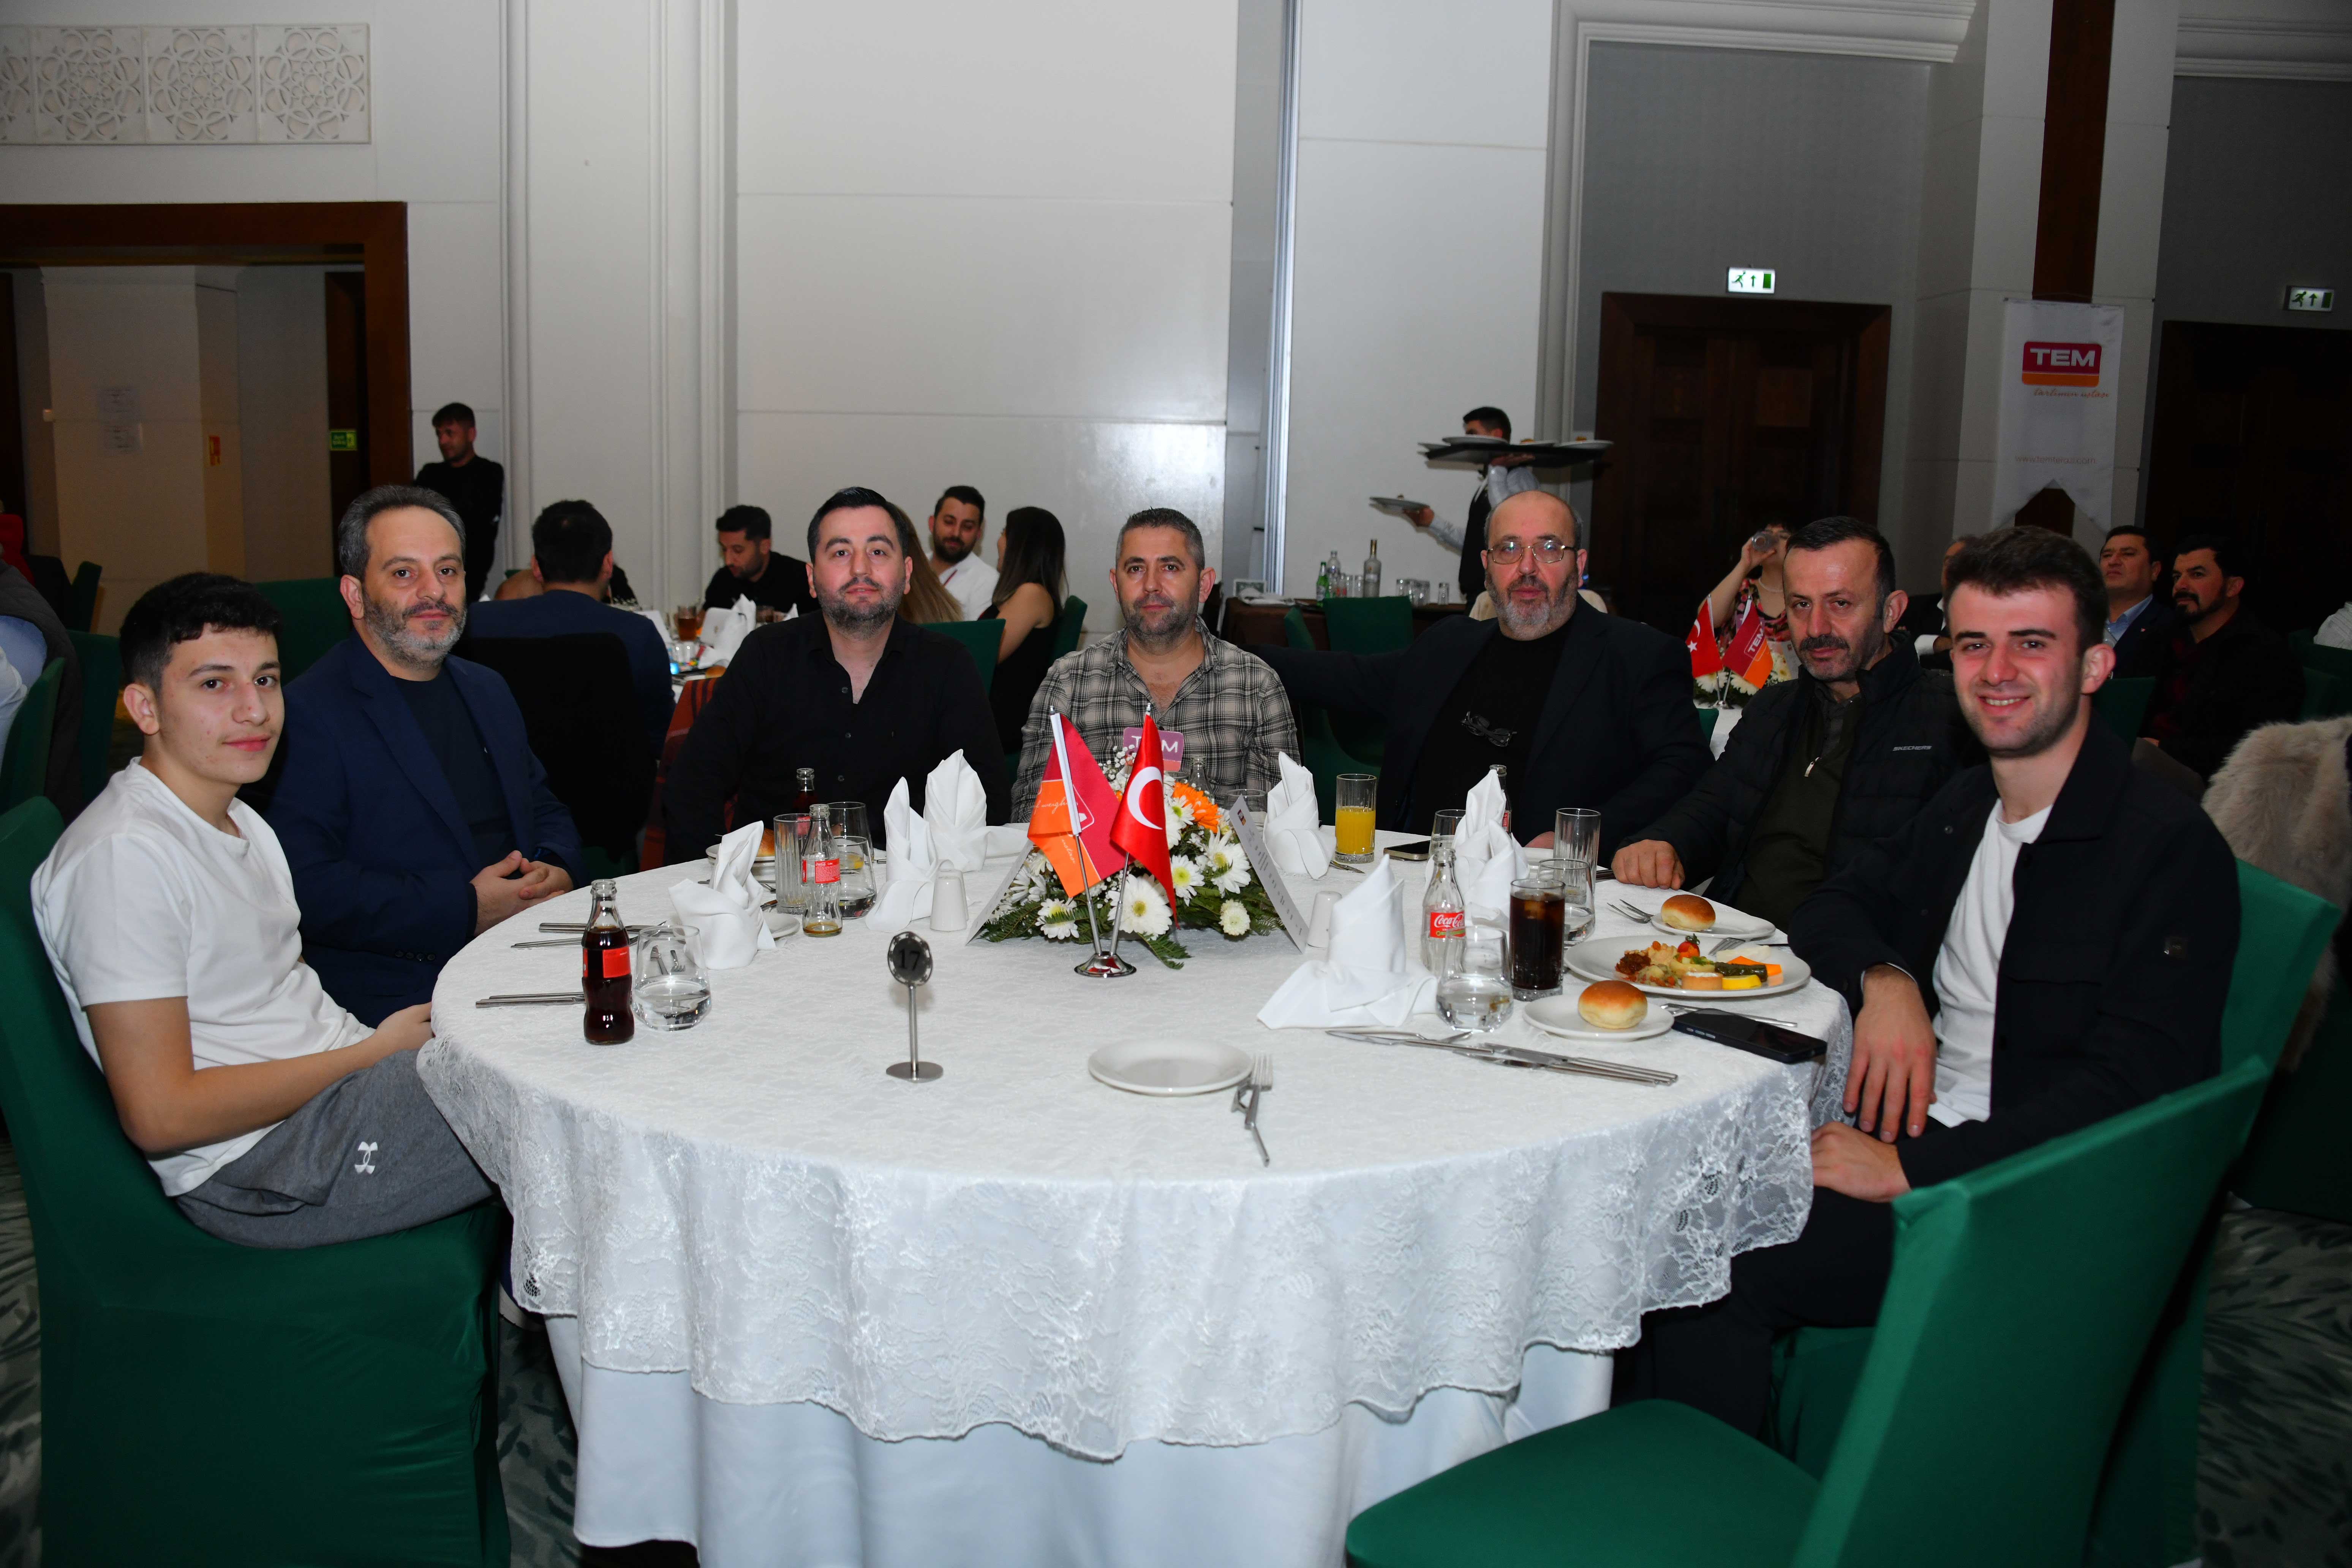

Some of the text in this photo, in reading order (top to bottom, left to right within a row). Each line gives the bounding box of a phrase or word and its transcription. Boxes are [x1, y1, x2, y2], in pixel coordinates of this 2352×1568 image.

[2030, 348, 2096, 367] TEM
[1748, 628, 1764, 653] TEM
[1131, 735, 1178, 753] TM
[899, 948, 921, 970] 17
